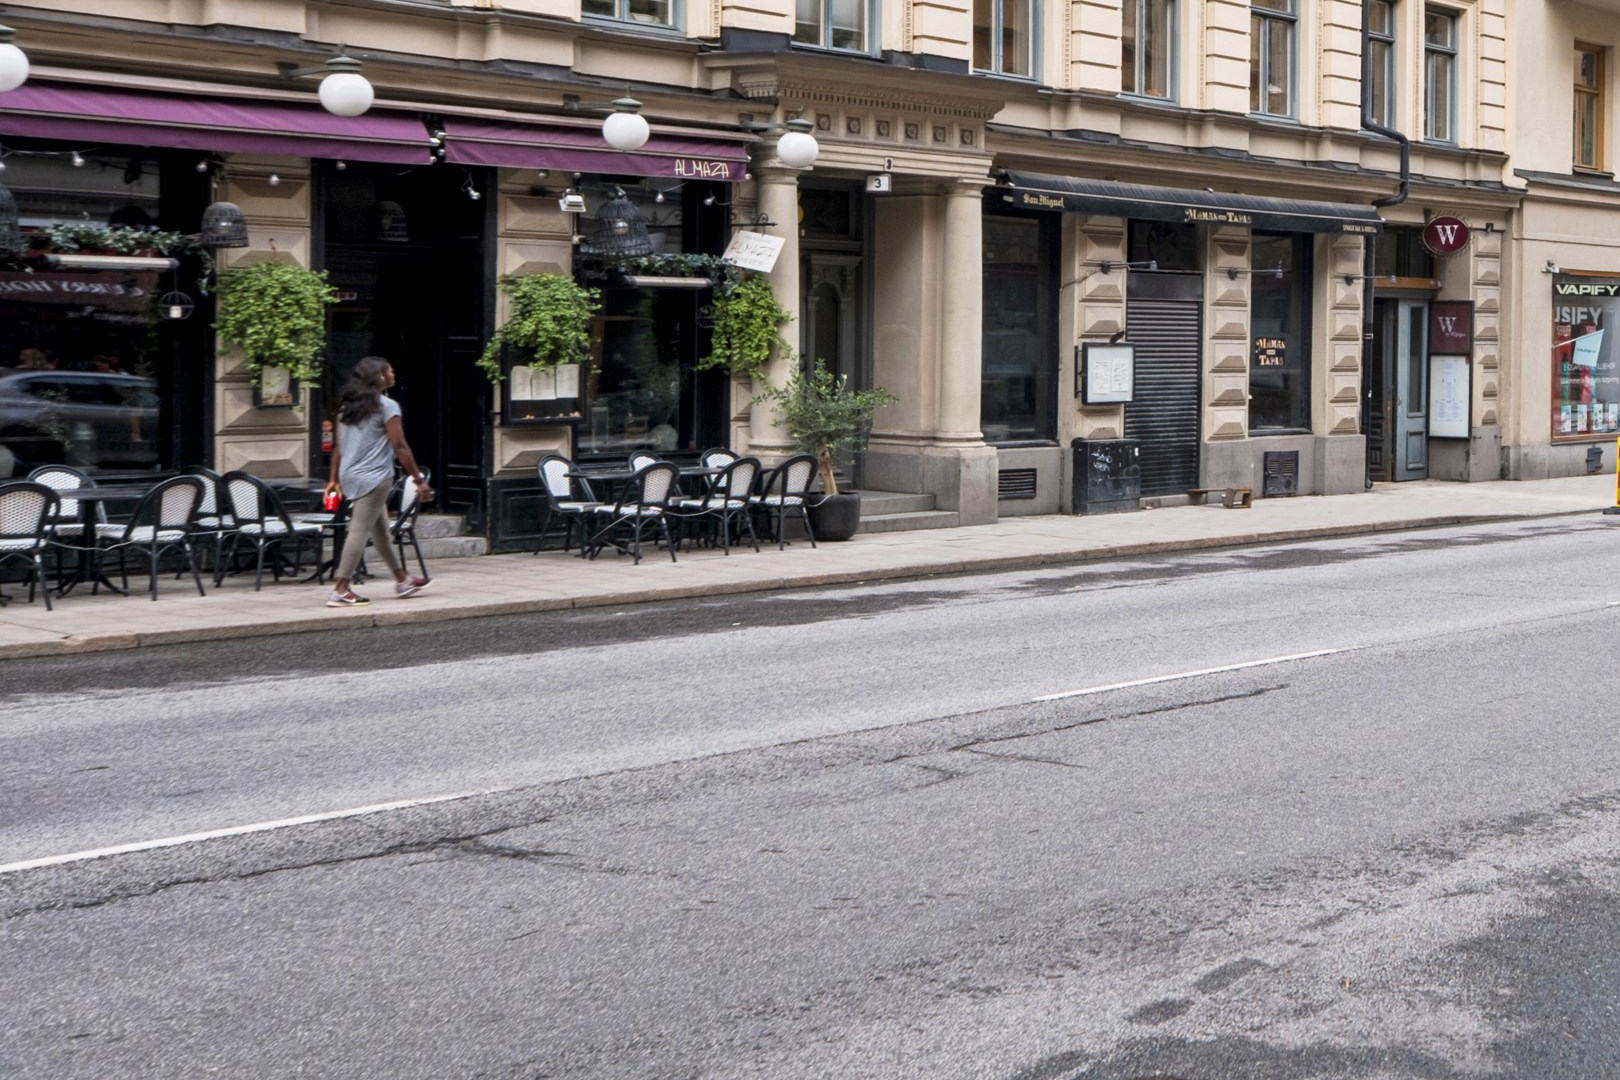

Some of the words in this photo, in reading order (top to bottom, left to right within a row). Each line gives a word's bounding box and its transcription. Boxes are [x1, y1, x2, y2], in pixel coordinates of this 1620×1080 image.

[674, 159, 729, 179] ALMAZA
[886, 159, 892, 170] 3
[874, 178, 882, 189] 3
[1023, 193, 1039, 204] San
[1434, 224, 1459, 246] W
[1555, 284, 1619, 296] VAPIFY
[1437, 316, 1457, 333] W
[1259, 355, 1284, 366] TAPAS
